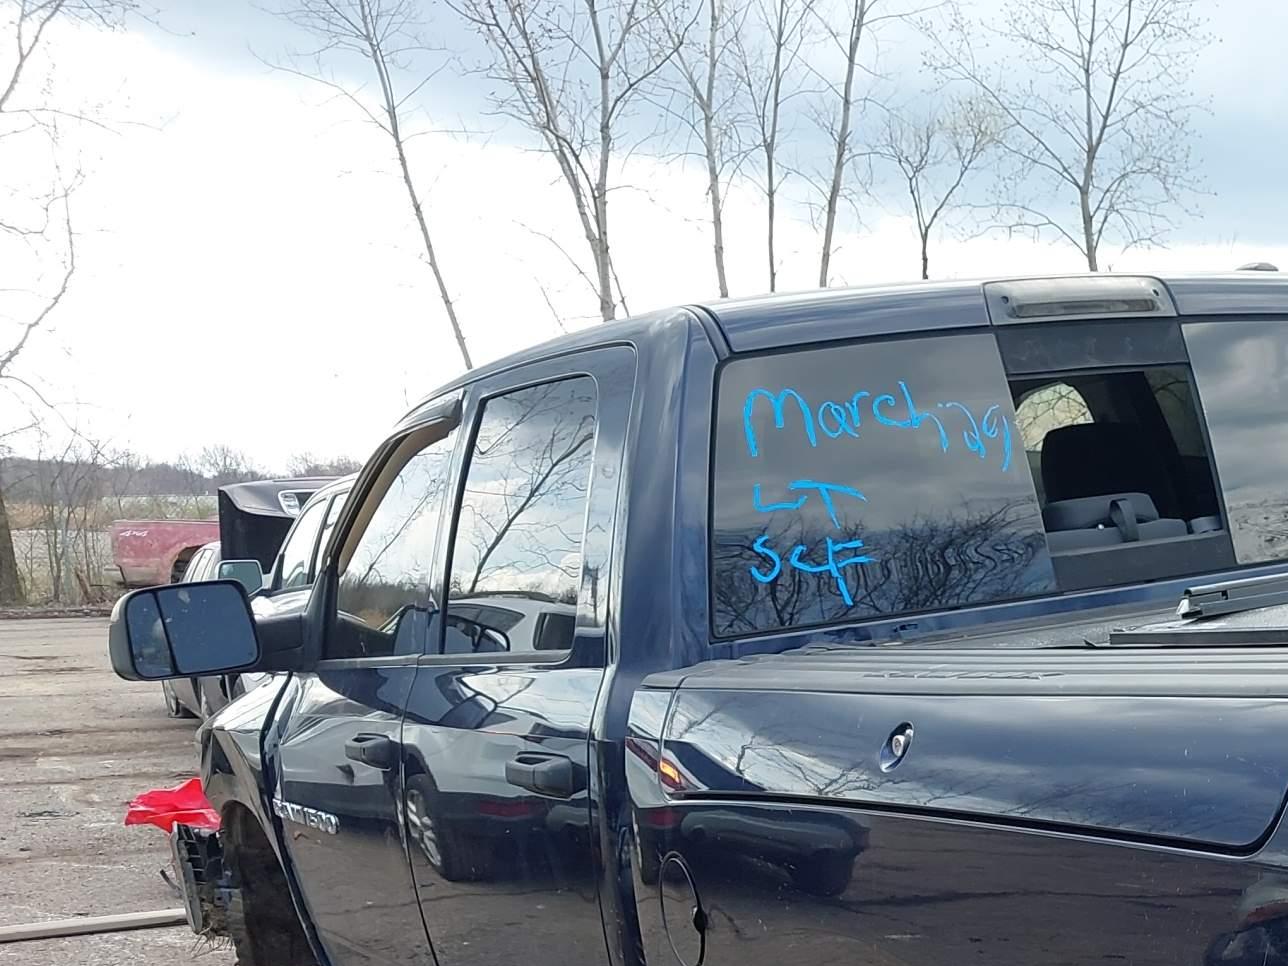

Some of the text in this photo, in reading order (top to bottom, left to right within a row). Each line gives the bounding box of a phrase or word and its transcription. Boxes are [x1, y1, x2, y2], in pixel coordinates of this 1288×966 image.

[743, 382, 1011, 473] March 29
[753, 478, 869, 529] LT
